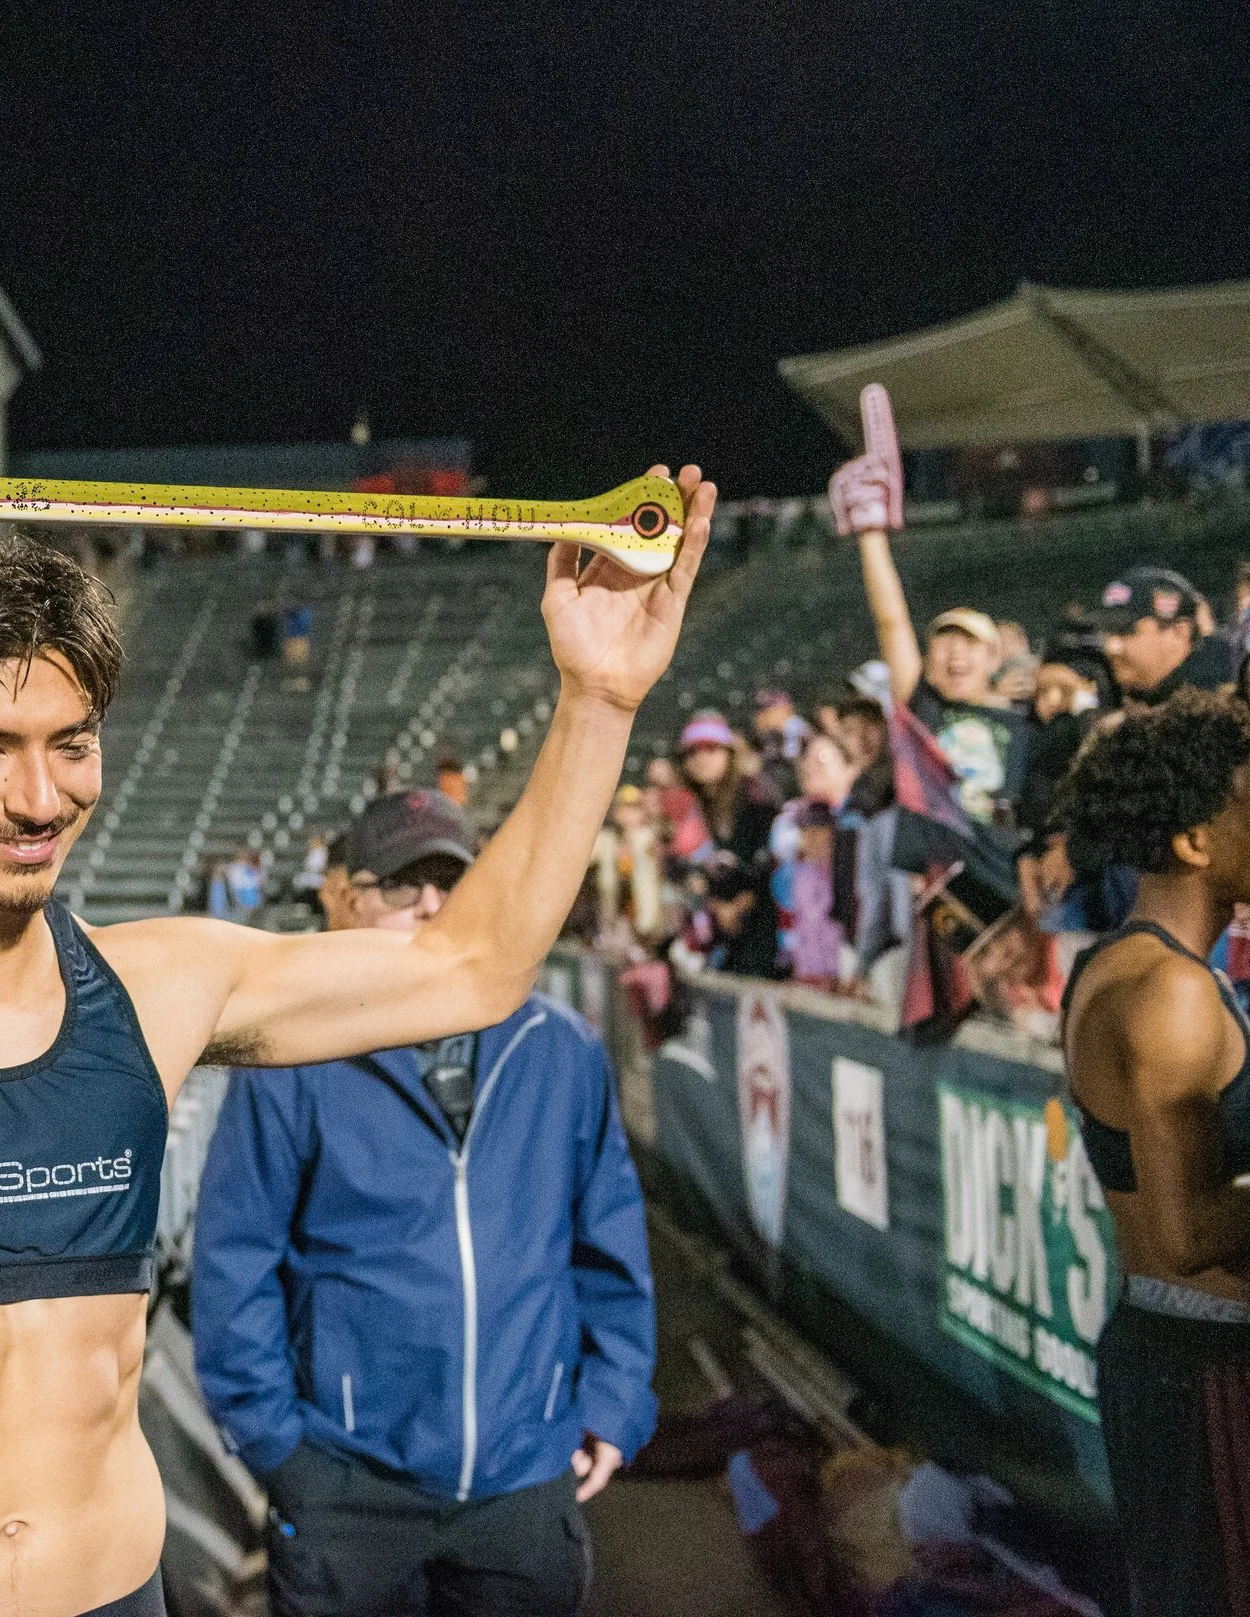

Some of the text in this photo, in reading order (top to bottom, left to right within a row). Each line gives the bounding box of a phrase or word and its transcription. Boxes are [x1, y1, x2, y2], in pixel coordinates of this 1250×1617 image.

[362, 499, 425, 529] COL
[464, 503, 535, 533] HOU
[939, 1090, 1107, 1345] DICK'S
